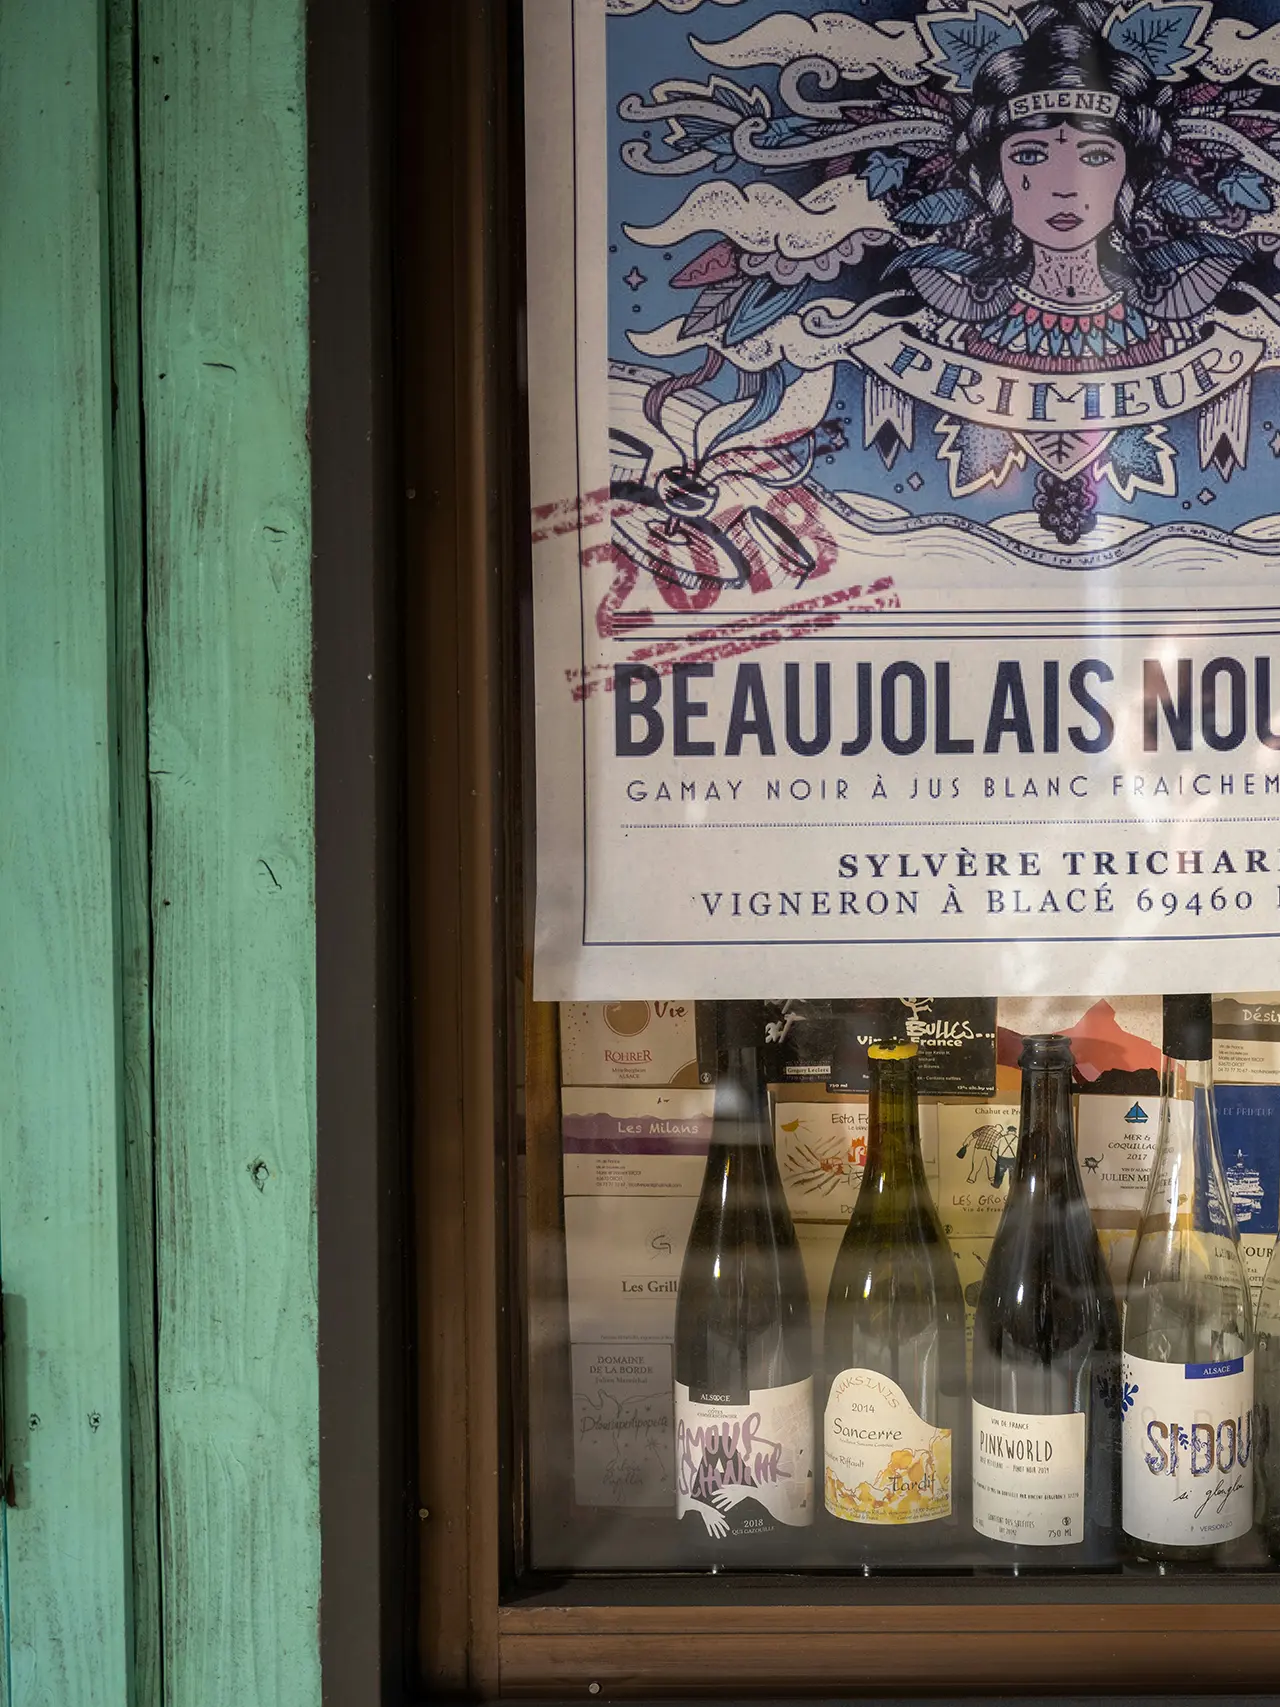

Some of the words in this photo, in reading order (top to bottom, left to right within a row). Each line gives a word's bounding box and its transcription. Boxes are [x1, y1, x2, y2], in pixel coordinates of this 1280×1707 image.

[1013, 91, 1113, 115] SELENE
[885, 344, 1244, 422] PRIMEUR
[614, 657, 1115, 757] BEAUJOLAIS
[626, 778, 743, 802] GAMAY
[766, 778, 849, 801] NOIR
[871, 772, 888, 800] À
[909, 777, 961, 799] JUS
[984, 776, 1088, 799] BLANC
[837, 847, 1042, 879] SYLVÈRE
[702, 889, 920, 918] VIGNERON
[941, 883, 964, 914] À
[987, 882, 1115, 915] BLACÉ
[1136, 886, 1253, 917] 69460
[654, 1000, 689, 1018] Vie
[604, 1050, 653, 1065] ROHRER
[975, 1107, 1001, 1115] Chahut
[831, 1113, 856, 1125] Esta
[618, 1122, 642, 1134] Les
[649, 1122, 700, 1135] Milans
[1123, 1133, 1142, 1142] MER
[1126, 1153, 1148, 1161] 2017
[1100, 1173, 1136, 1182] JULIEN
[952, 1195, 972, 1206] LES
[621, 1280, 643, 1293] Les
[597, 1356, 645, 1365] DOMAINE
[619, 1366, 653, 1374] BORDE
[1202, 1365, 1231, 1376] ALSACE
[851, 1402, 876, 1414] 2014
[833, 1417, 904, 1441] Sancerre
[888, 1470, 937, 1492] Tardif
[743, 1519, 764, 1528] 2018
[1199, 1523, 1225, 1532] VERSION
